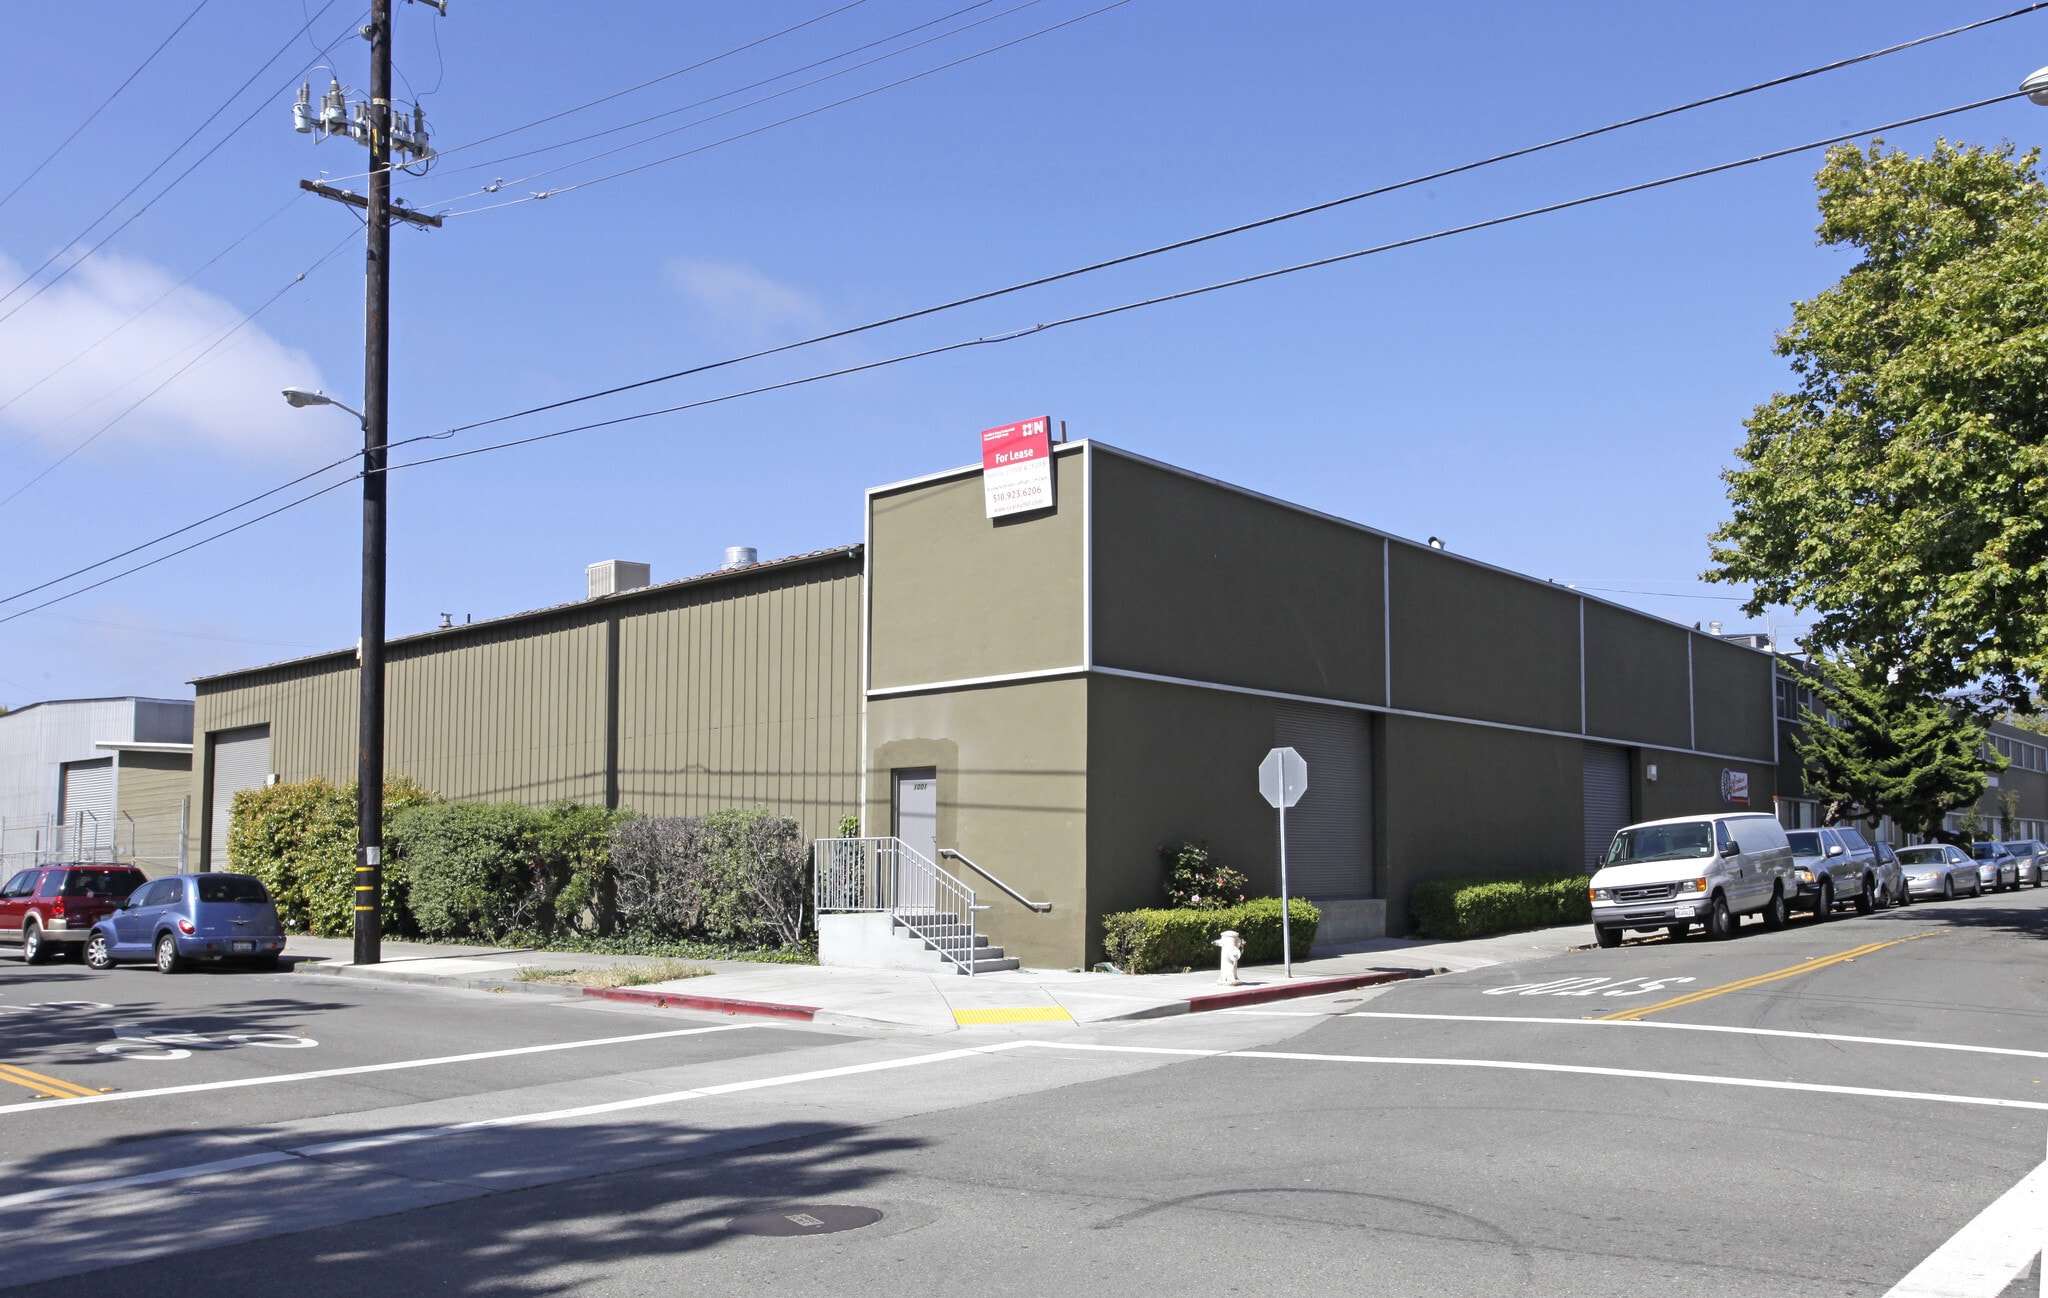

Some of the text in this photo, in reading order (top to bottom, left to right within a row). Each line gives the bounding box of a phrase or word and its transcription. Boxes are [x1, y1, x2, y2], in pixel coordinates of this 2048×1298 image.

[995, 448, 1034, 464] For Lease
[993, 485, 1042, 503] 510.923.6206
